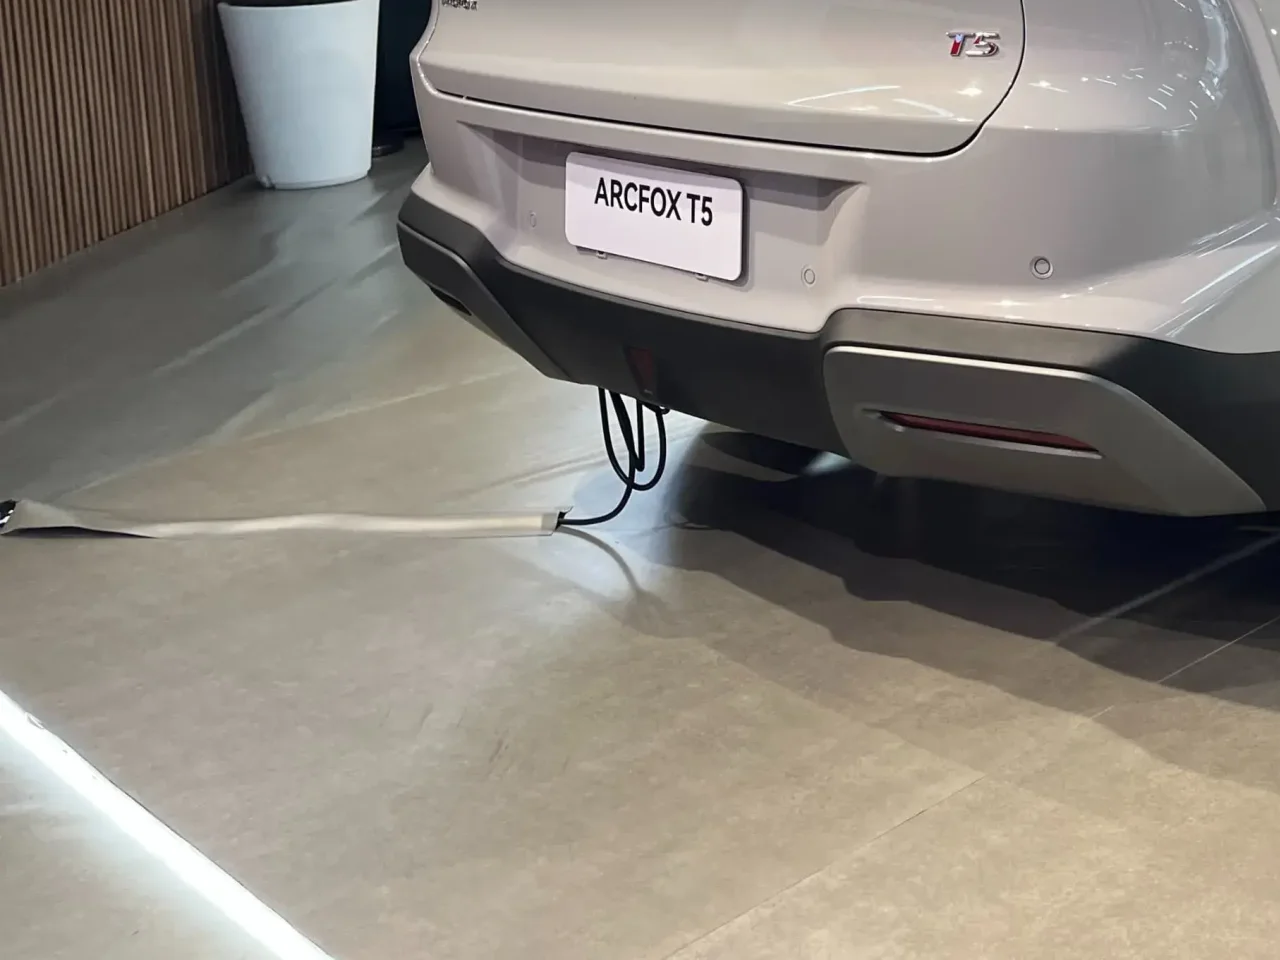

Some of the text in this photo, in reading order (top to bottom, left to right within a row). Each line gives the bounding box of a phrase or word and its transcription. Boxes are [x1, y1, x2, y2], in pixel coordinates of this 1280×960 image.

[945, 31, 1000, 57] T5
[594, 177, 713, 226] ARCFOX T5
